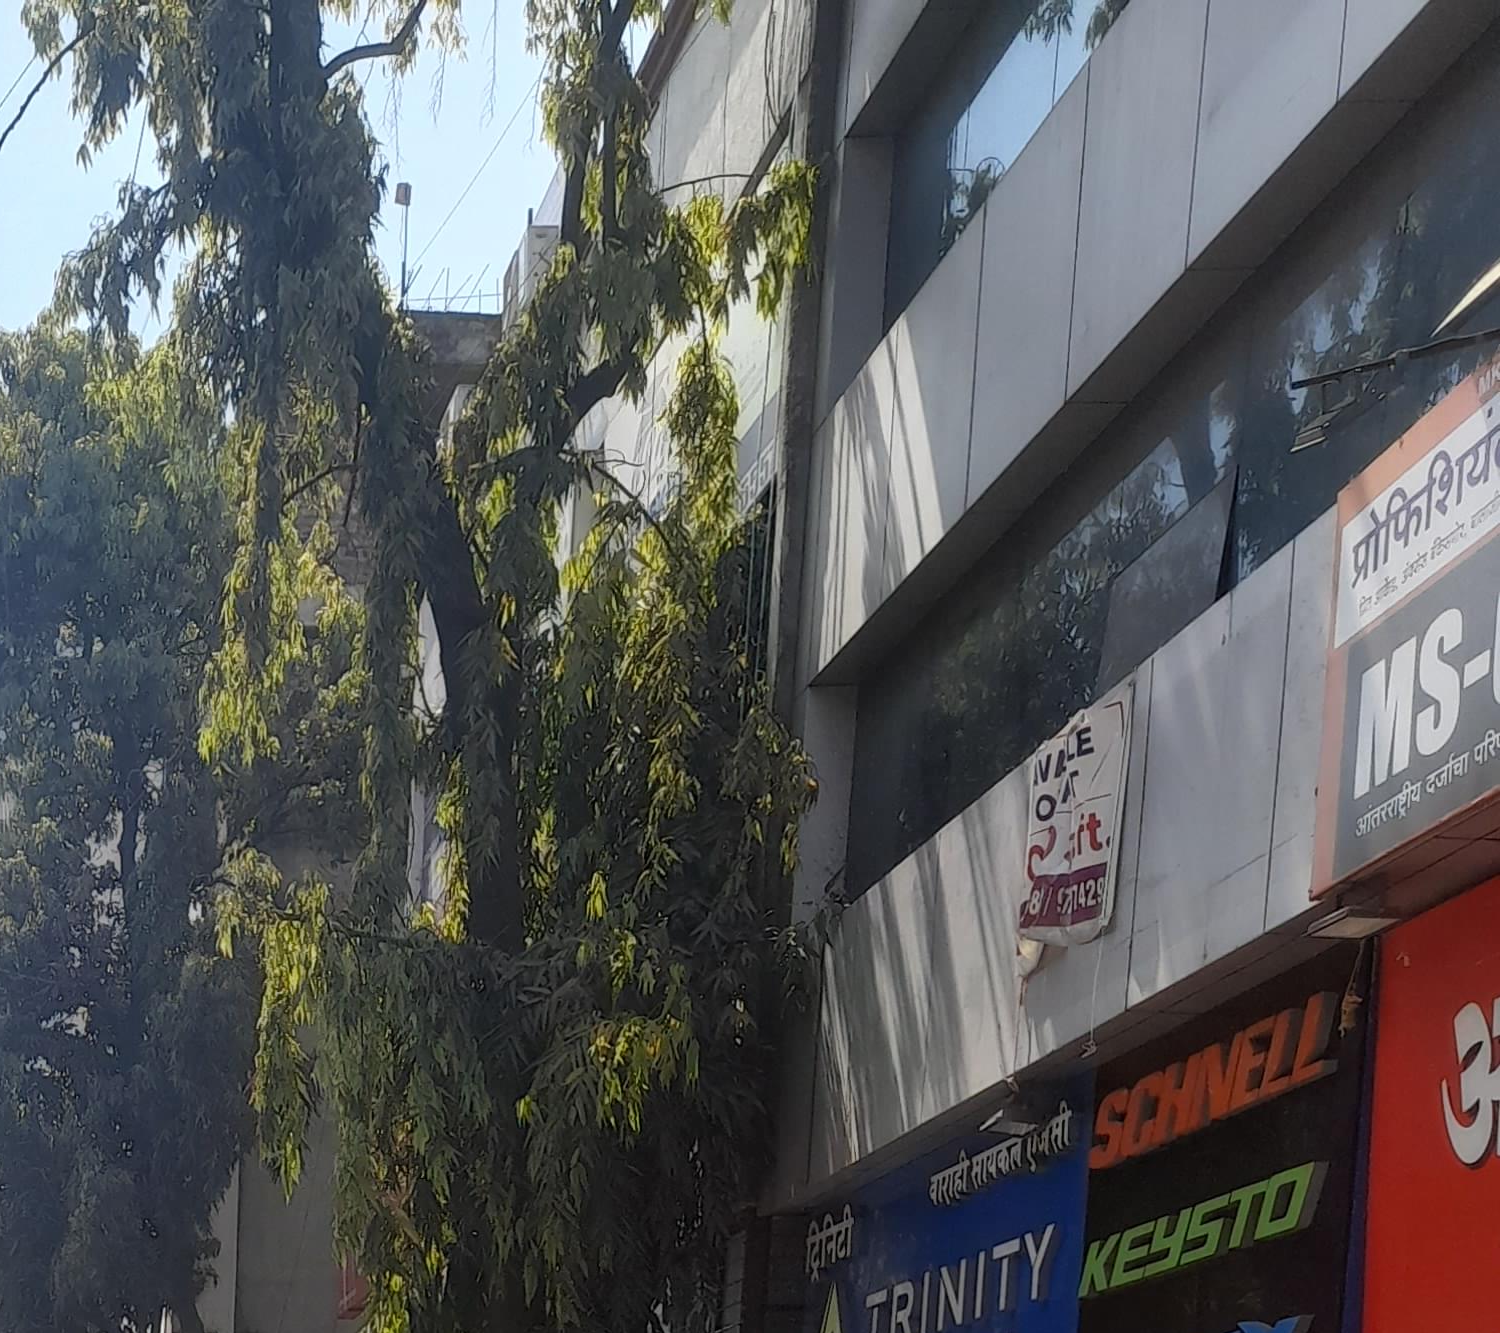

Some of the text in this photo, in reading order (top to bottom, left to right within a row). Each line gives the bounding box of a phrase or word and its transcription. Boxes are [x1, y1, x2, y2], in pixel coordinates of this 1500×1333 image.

[1353, 592, 1500, 801] MS-
[1355, 781, 1422, 838] आंतरराष्ट्रीय
[1426, 750, 1470, 795] दर्जाचा
[1089, 990, 1339, 1170] SCHNELL
[1078, 1160, 1316, 1298] KEYSTO
